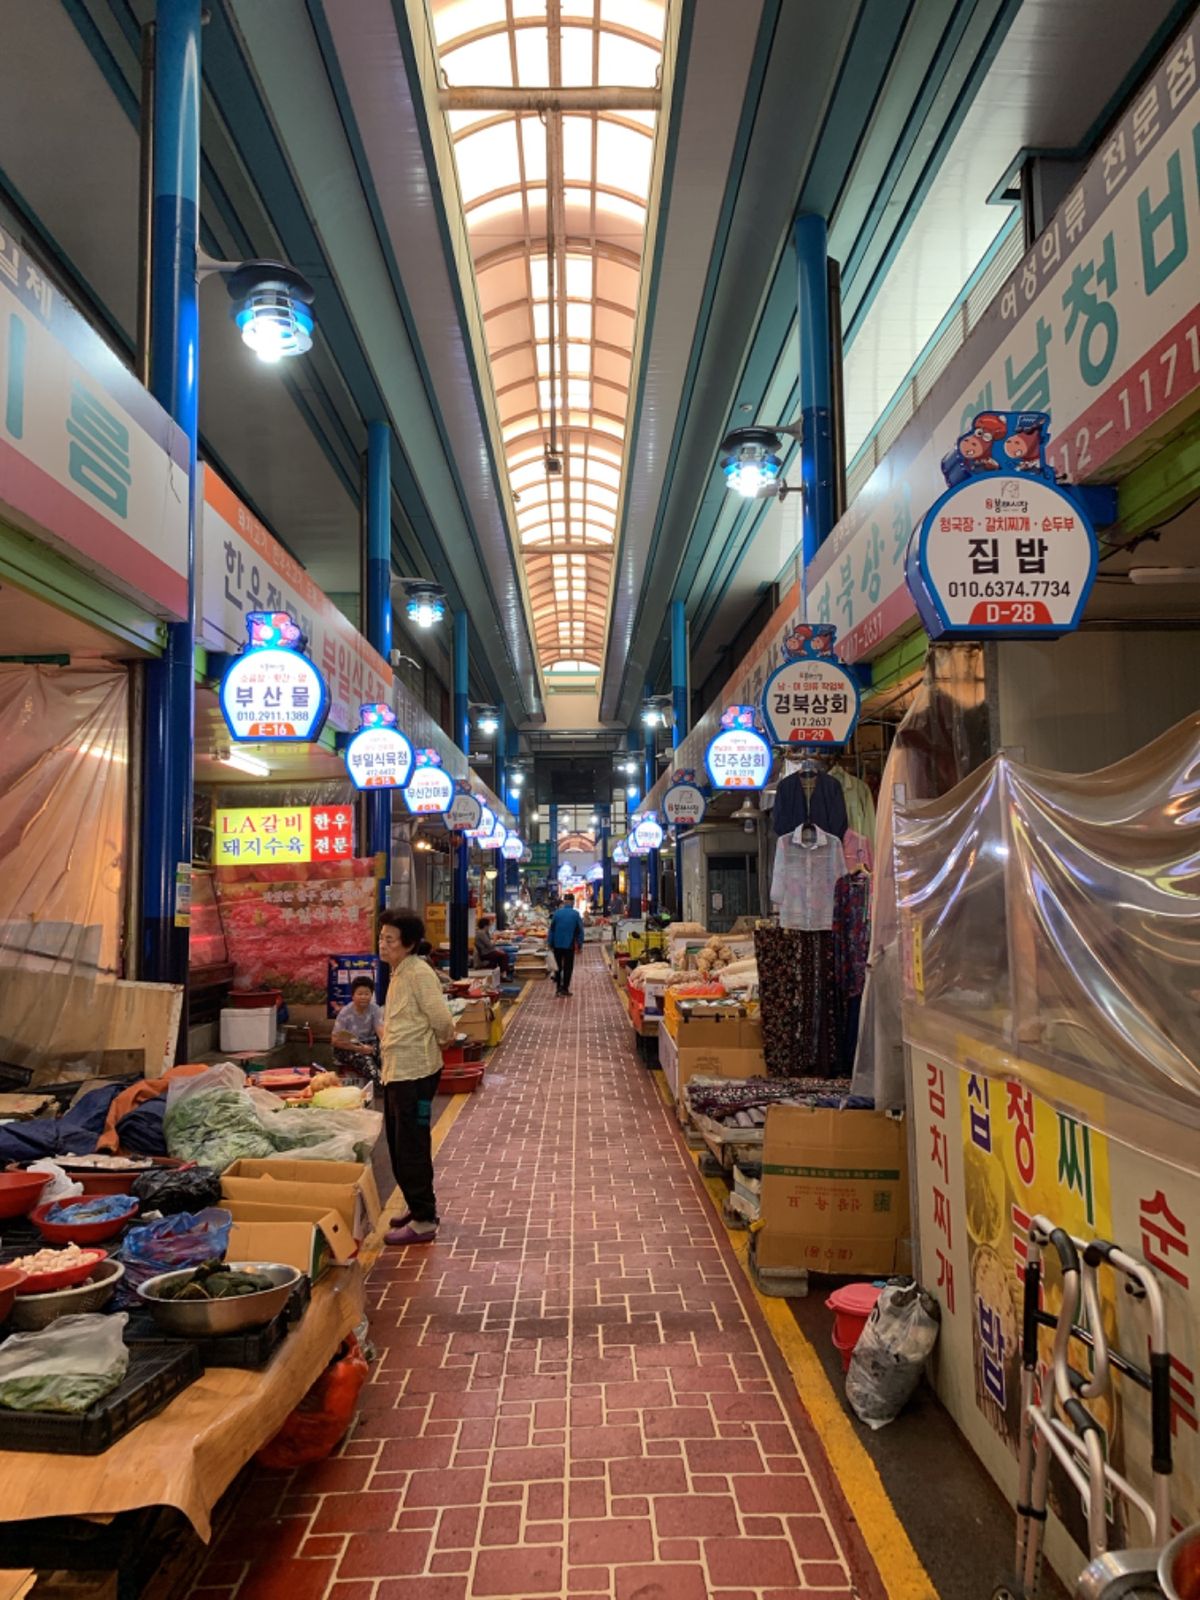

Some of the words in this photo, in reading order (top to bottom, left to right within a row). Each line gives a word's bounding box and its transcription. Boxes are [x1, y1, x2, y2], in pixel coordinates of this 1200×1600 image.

[1001, 187, 1086, 320] 여성의류
[1102, 35, 1197, 196] 전문점
[1049, 325, 1200, 484] 12-1171
[940, 517, 974, 533] 청국장
[985, 517, 1031, 533] 갈치찌개
[1042, 517, 1075, 533] 순두부
[948, 581, 1071, 598] 010.6374.7734
[986, 604, 1035, 623] D-28
[774, 693, 848, 714] 경북상회
[258, 724, 287, 736] E-16
[790, 717, 833, 727] 417.2637
[798, 730, 825, 740] D-29
[352, 752, 408, 767] 부일식육점
[714, 753, 765, 768] 진주상회
[313, 812, 349, 832] 한우
[223, 837, 305, 857] 돼지수육
[314, 836, 349, 854] 전문
[927, 1063, 955, 1314] 김치찌개
